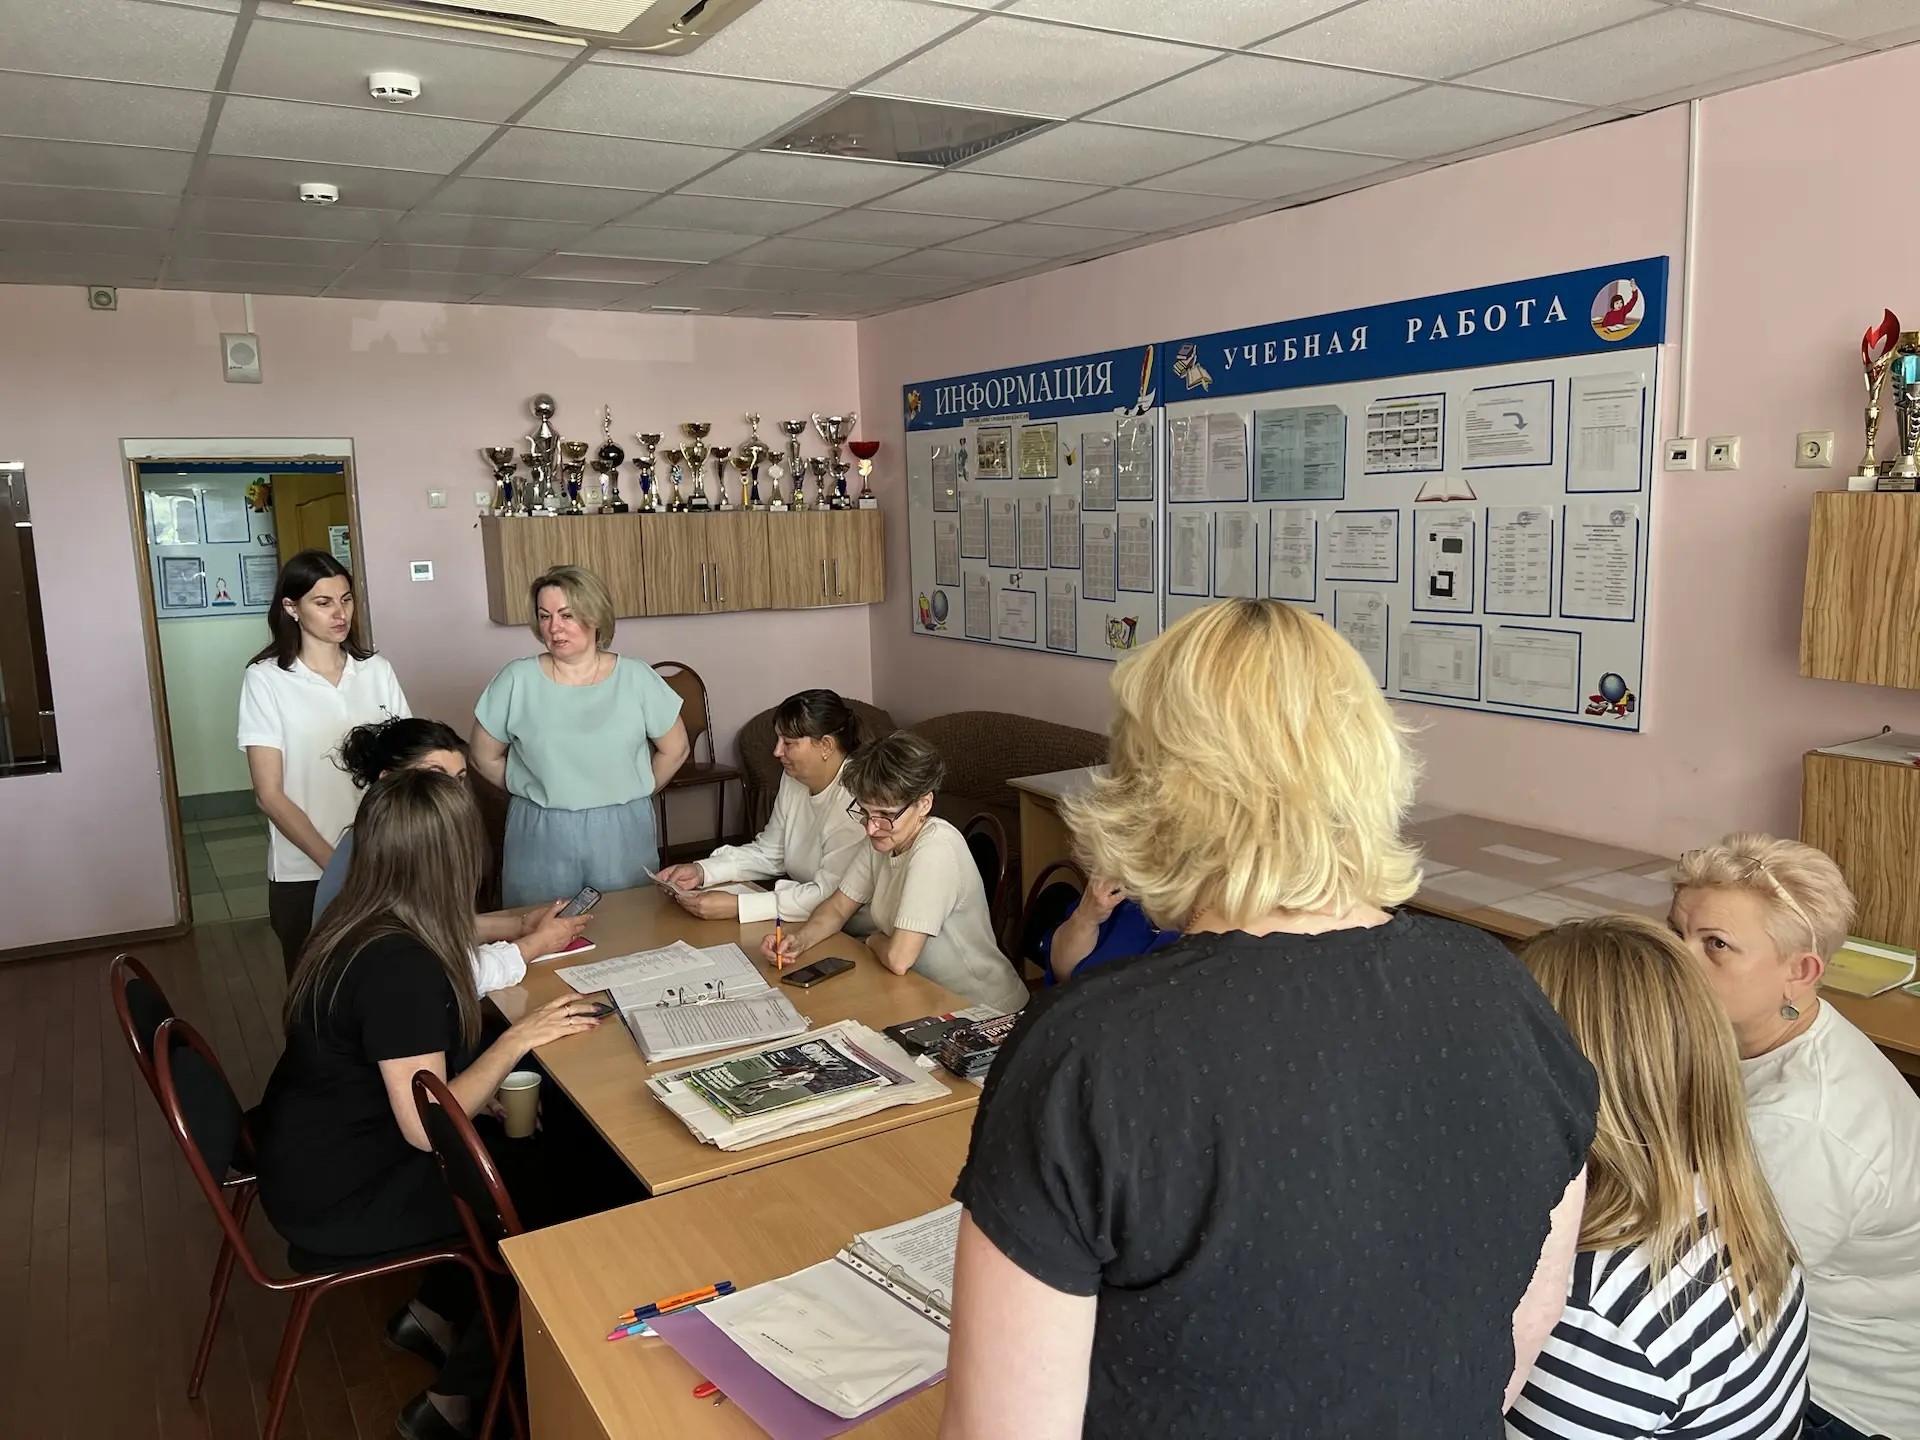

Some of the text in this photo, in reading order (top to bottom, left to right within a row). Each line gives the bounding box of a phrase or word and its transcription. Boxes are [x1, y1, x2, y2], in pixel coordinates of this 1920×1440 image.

[1223, 295, 1567, 370] УЧЕБНАЯ РАБОТА
[935, 360, 1114, 416] ИНФОРМАЦИЯ
